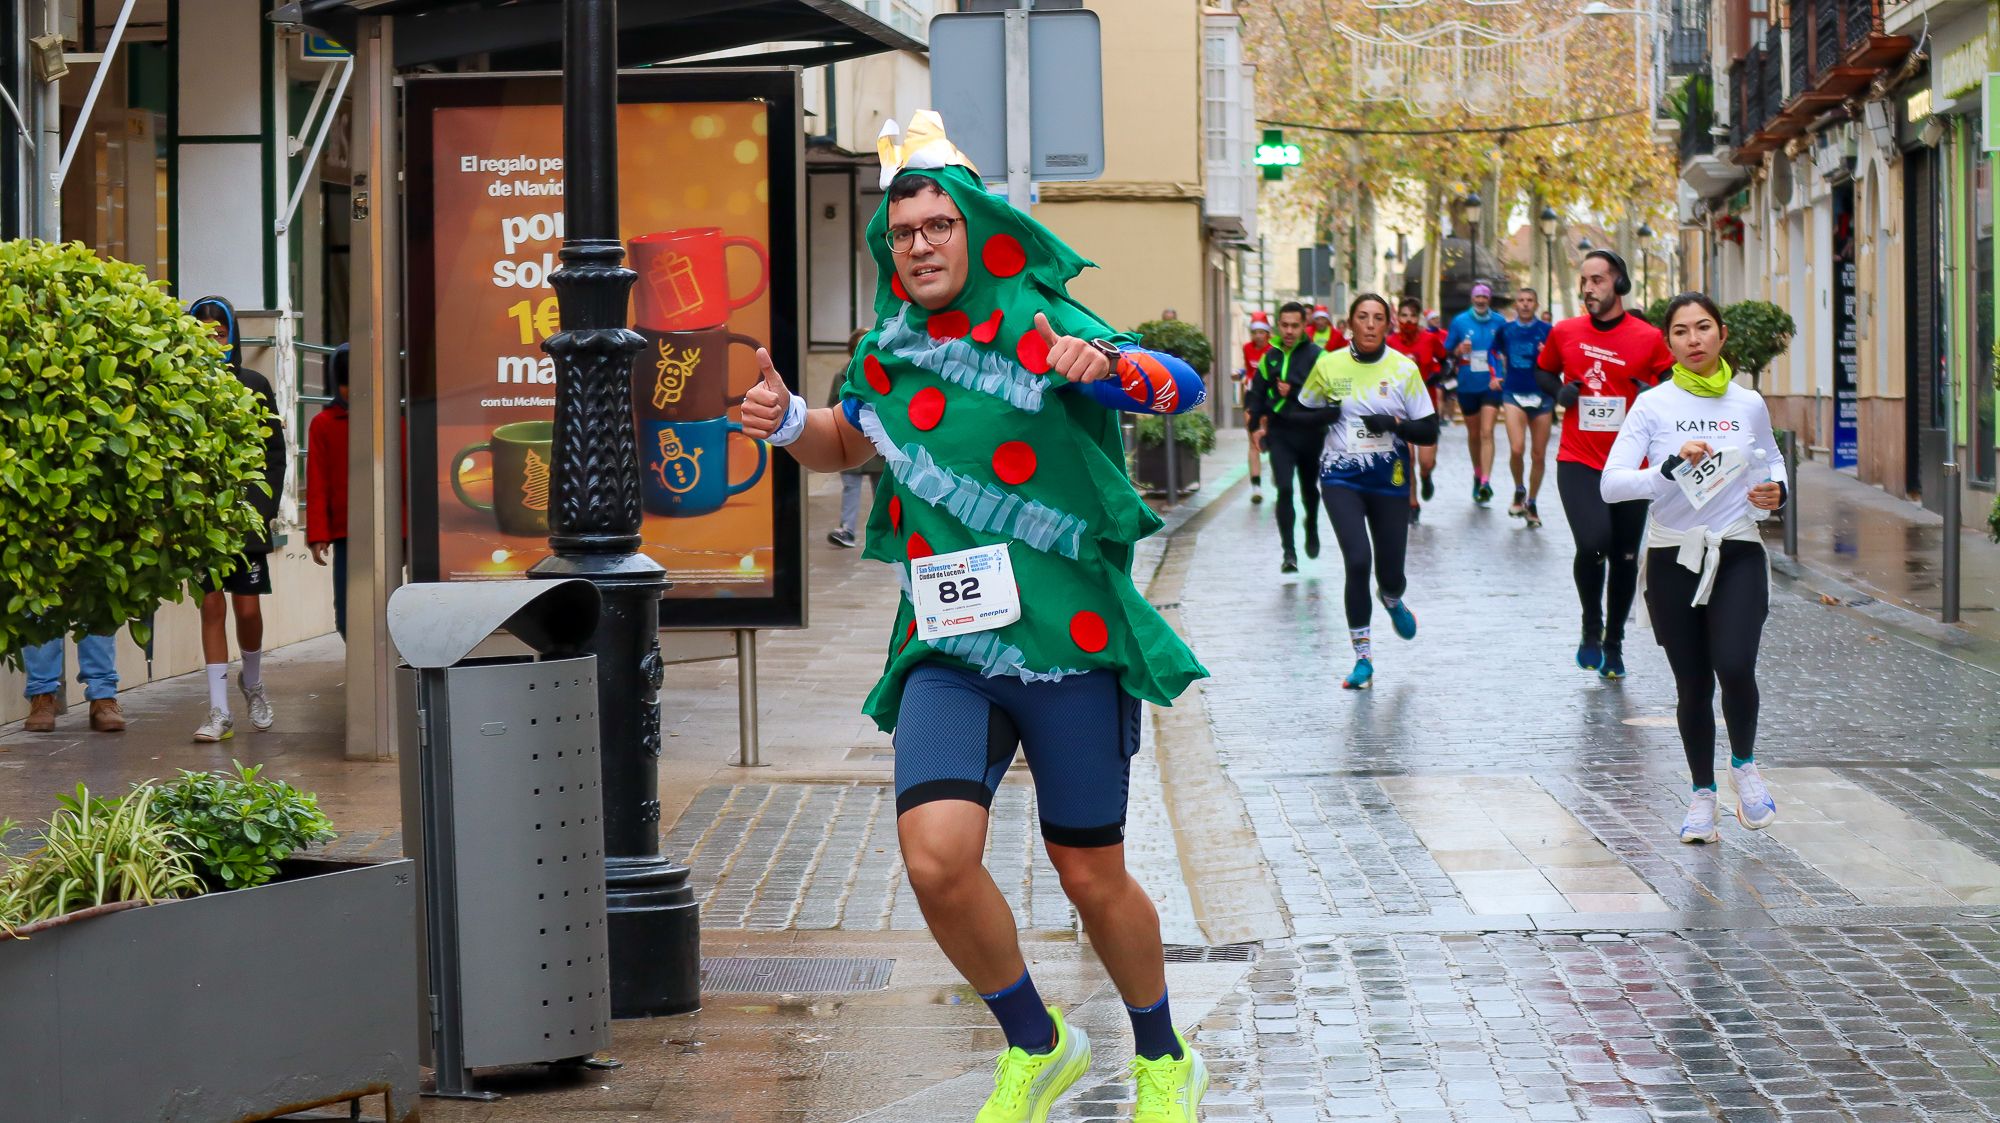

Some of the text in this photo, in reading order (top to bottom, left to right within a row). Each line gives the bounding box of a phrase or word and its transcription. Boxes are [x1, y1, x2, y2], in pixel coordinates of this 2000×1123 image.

[460, 155, 477, 172] El
[479, 154, 537, 176] regalo
[488, 180, 512, 197] de
[492, 253, 563, 289] sol
[481, 398, 501, 407] con
[501, 397, 513, 407] tu
[1588, 408, 1615, 418] 437
[1692, 451, 1723, 485] 357
[919, 566, 928, 574] San
[928, 564, 951, 573] Silvestre
[919, 568, 966, 581] Ciudad de Lucena
[939, 577, 981, 604] 82
[979, 608, 1008, 618] enerplus
